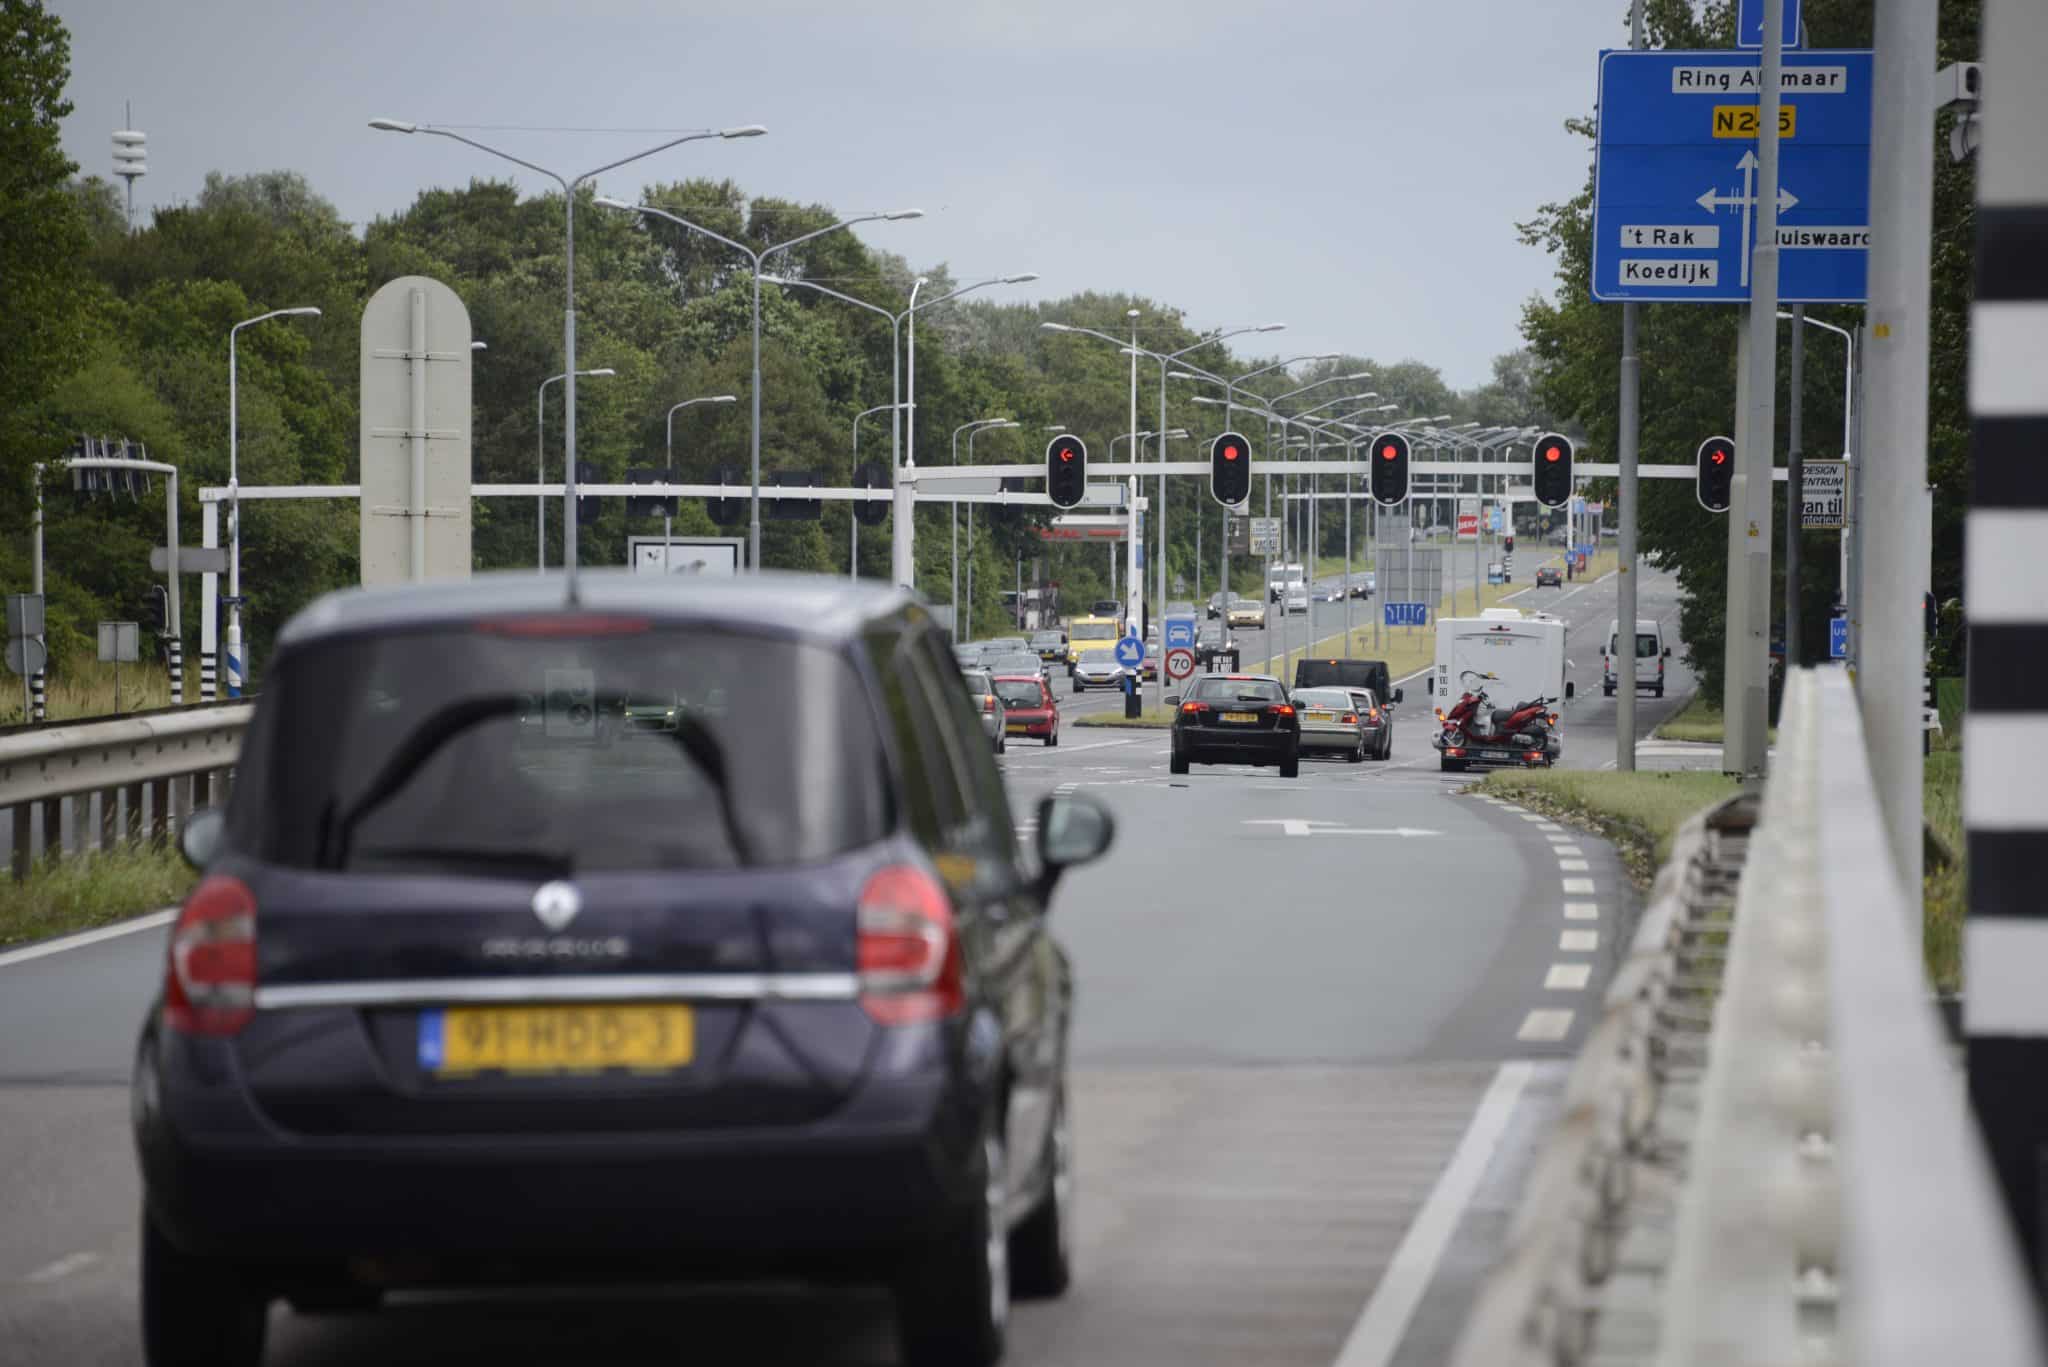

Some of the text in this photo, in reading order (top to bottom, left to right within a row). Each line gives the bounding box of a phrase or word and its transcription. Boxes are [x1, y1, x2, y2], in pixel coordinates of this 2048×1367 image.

[1679, 70, 1839, 91] Ring Almaar
[1717, 112, 1791, 131] N25
[1628, 229, 1695, 245] 't Rak
[1626, 263, 1711, 284] Koedijk
[1802, 477, 1844, 486] ENTRUM
[1828, 498, 1842, 513] til
[1802, 514, 1842, 524] nterieur
[1171, 658, 1190, 670] 70
